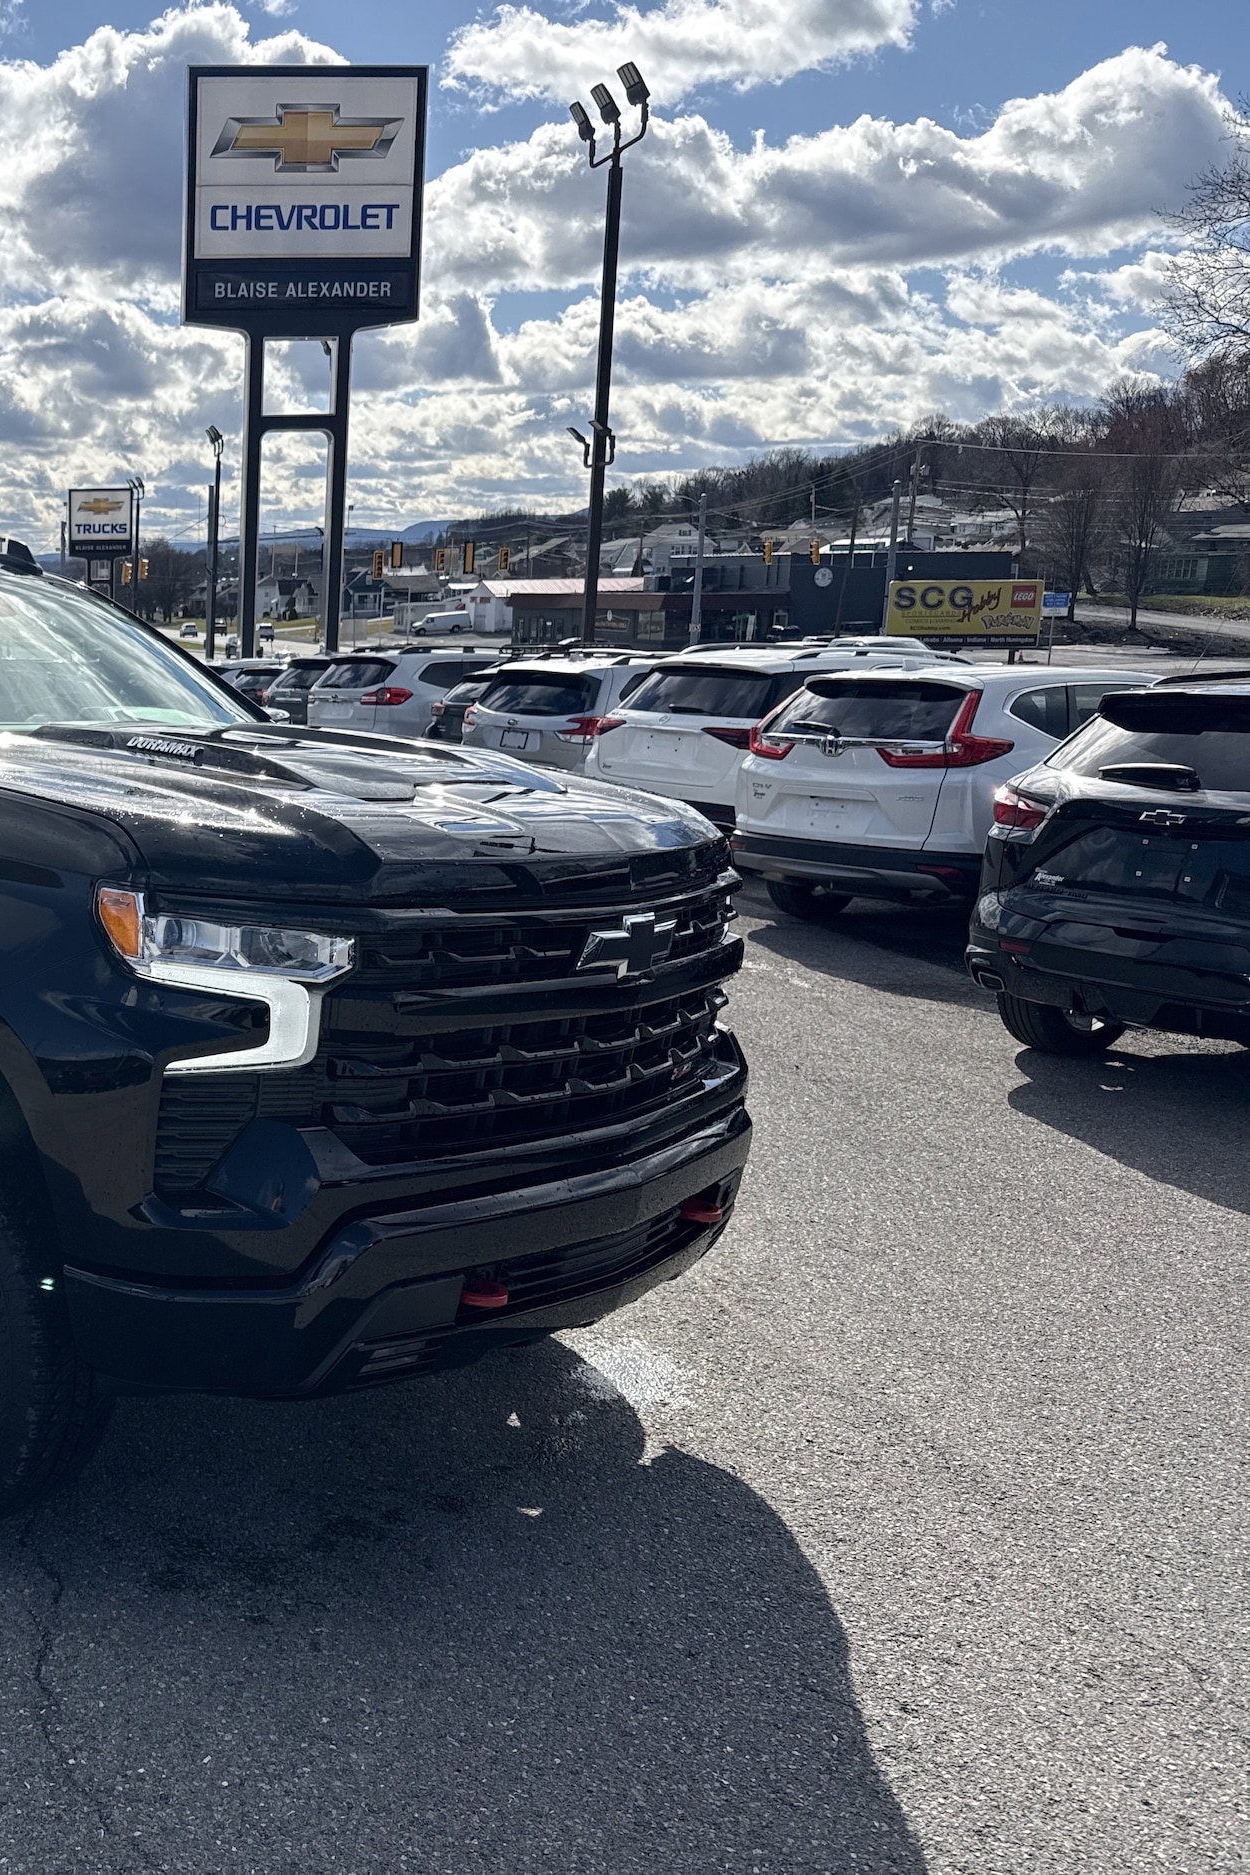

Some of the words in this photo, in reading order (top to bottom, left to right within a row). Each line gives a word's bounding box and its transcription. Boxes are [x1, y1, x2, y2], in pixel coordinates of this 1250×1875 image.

[210, 204, 400, 231] CHEVROLET
[214, 282, 278, 298] BLAISE
[285, 281, 391, 297] ALEXANDER
[75, 523, 127, 534] TRUCKS
[895, 586, 974, 610] SCG
[1013, 592, 1034, 601] LEGO
[127, 736, 204, 757] DURAMAX
